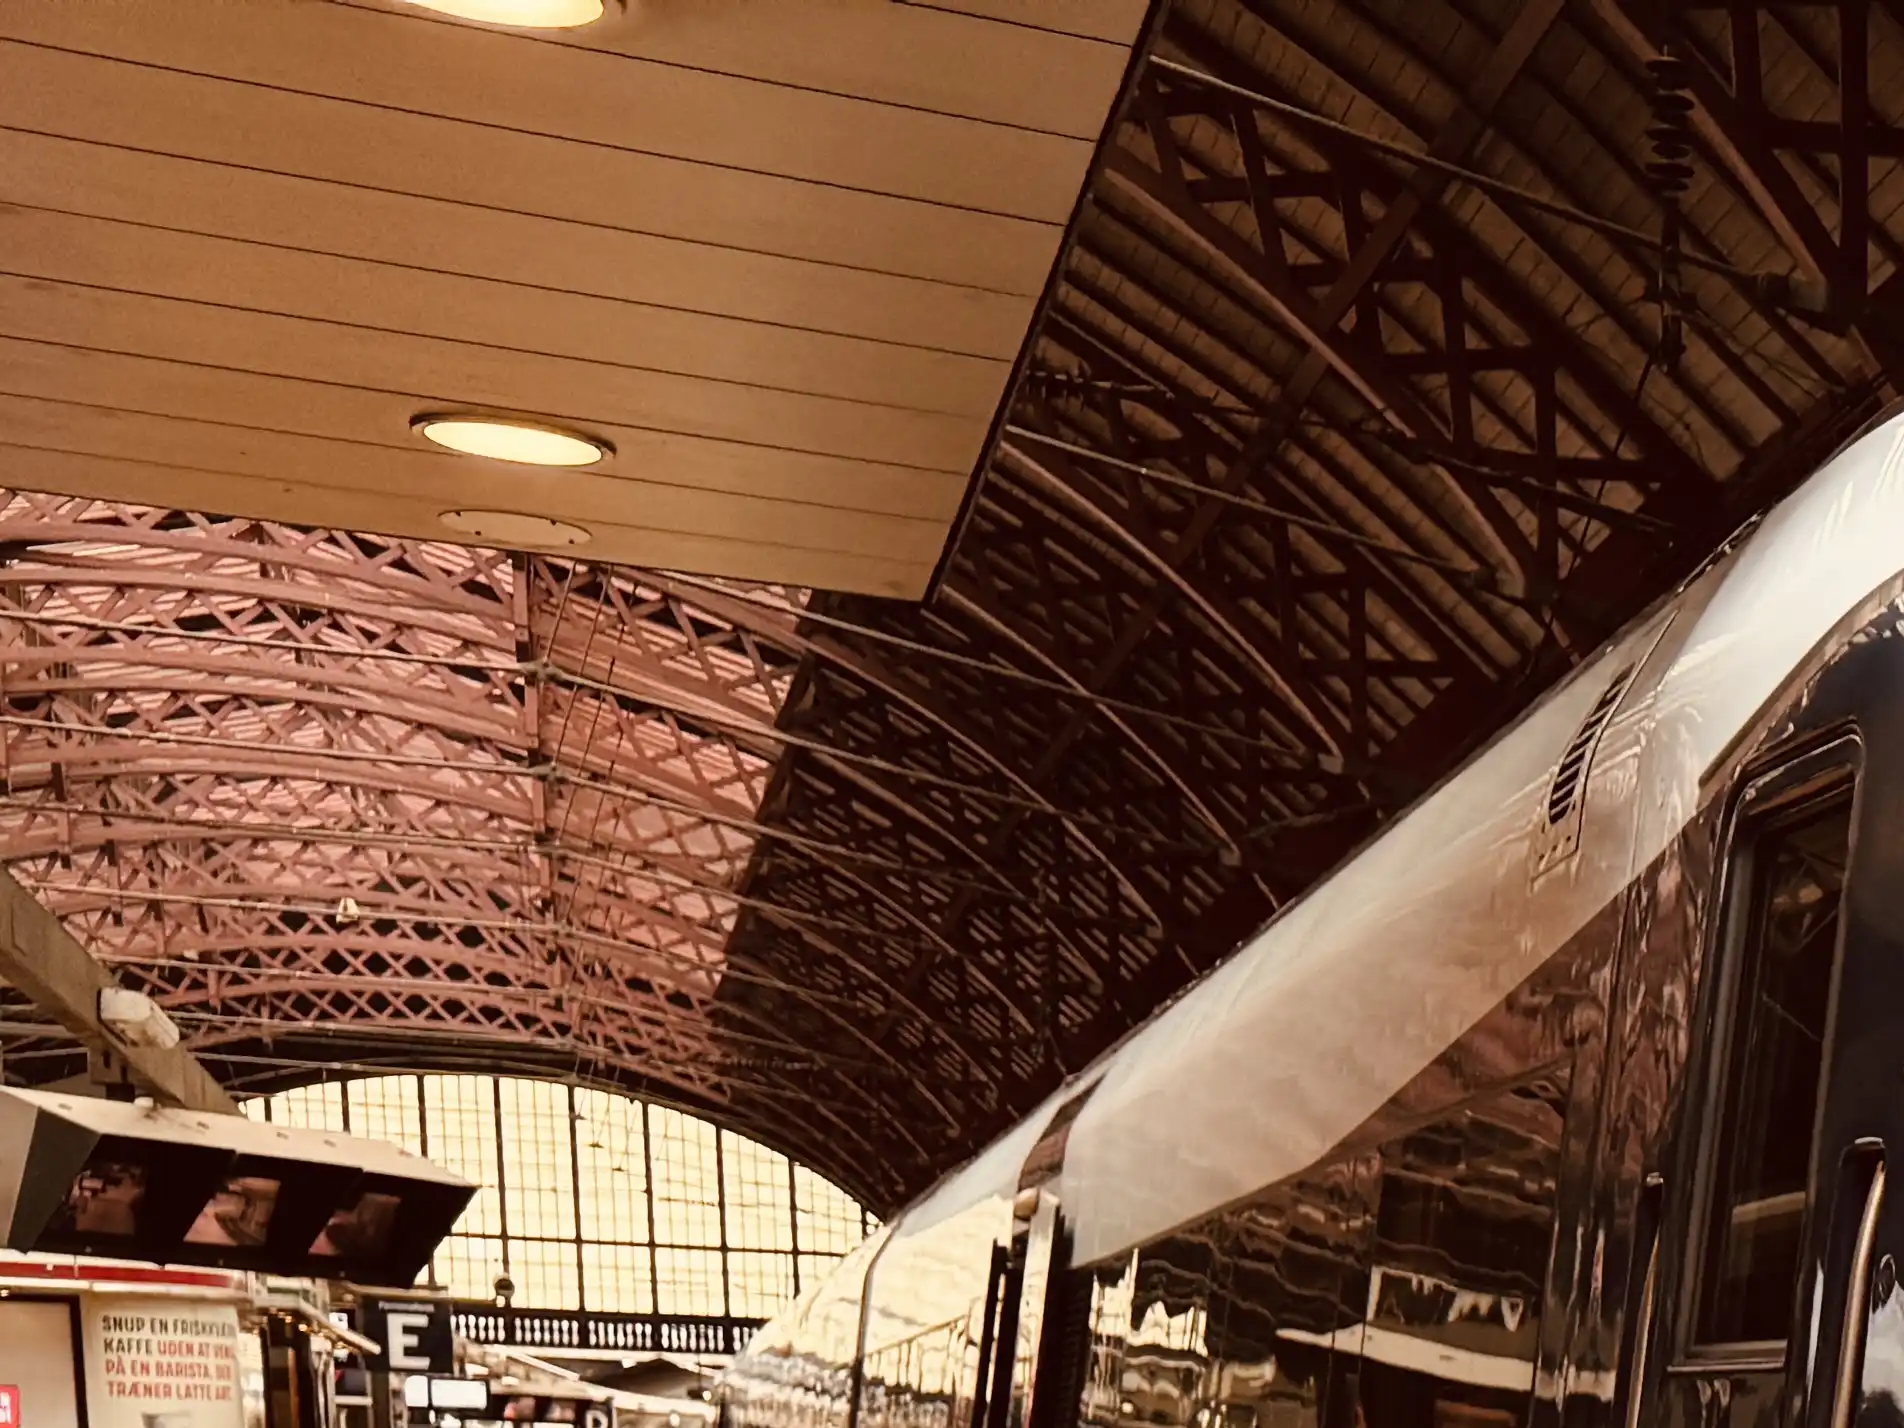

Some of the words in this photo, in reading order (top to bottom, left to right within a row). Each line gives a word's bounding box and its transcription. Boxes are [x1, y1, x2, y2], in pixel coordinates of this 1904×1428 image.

[102, 1315, 145, 1333] SNUP
[150, 1318, 168, 1335] EN
[103, 1338, 152, 1355] KAFFE
[157, 1340, 194, 1357] UDEN
[386, 1312, 430, 1370] E
[105, 1355, 126, 1376] PÅ
[130, 1359, 150, 1377] EN
[108, 1380, 172, 1399] TRÆNER
